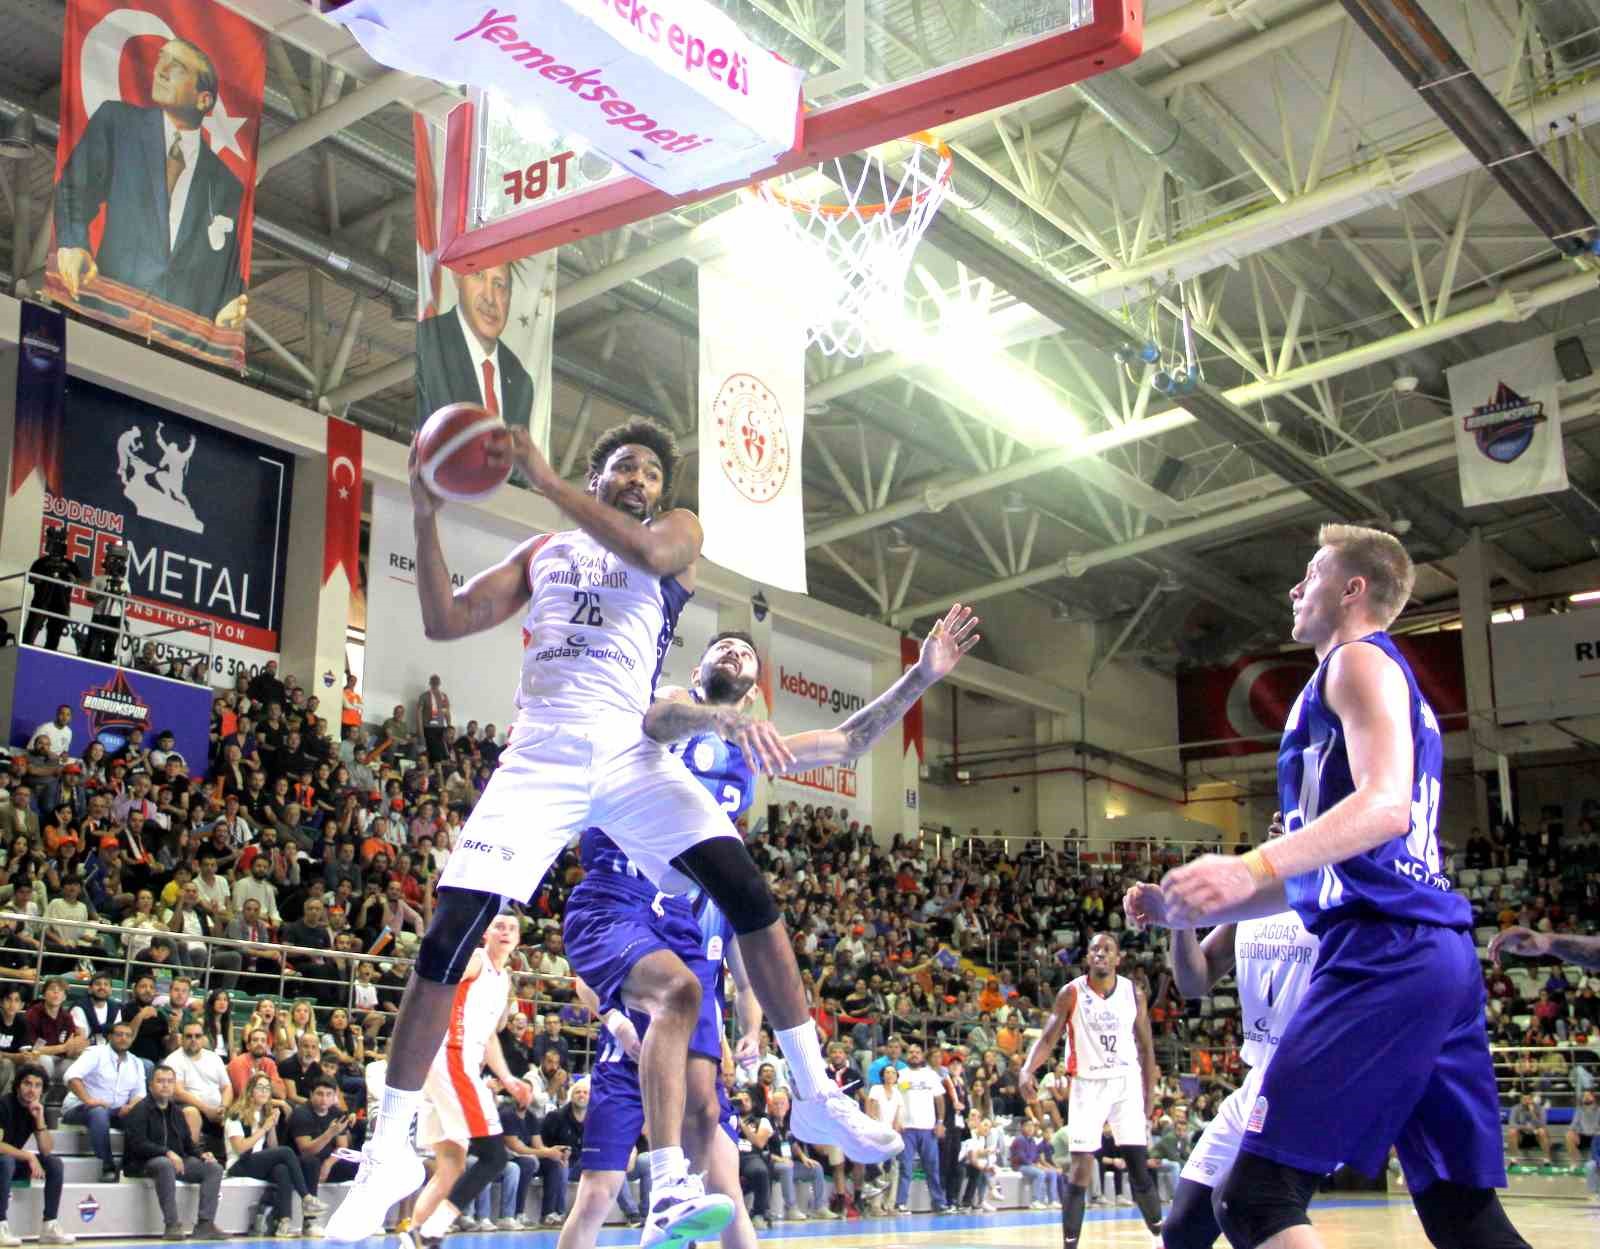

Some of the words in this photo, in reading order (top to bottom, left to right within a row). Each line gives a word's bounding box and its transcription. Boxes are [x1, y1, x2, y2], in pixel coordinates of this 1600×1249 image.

[603, 0, 748, 95] eksepeti
[42, 493, 124, 533] BODRUM
[126, 540, 261, 620] METAL
[569, 591, 603, 627] 26
[1239, 942, 1313, 964] BODRUMSPOR
[1099, 1034, 1117, 1053] 92
